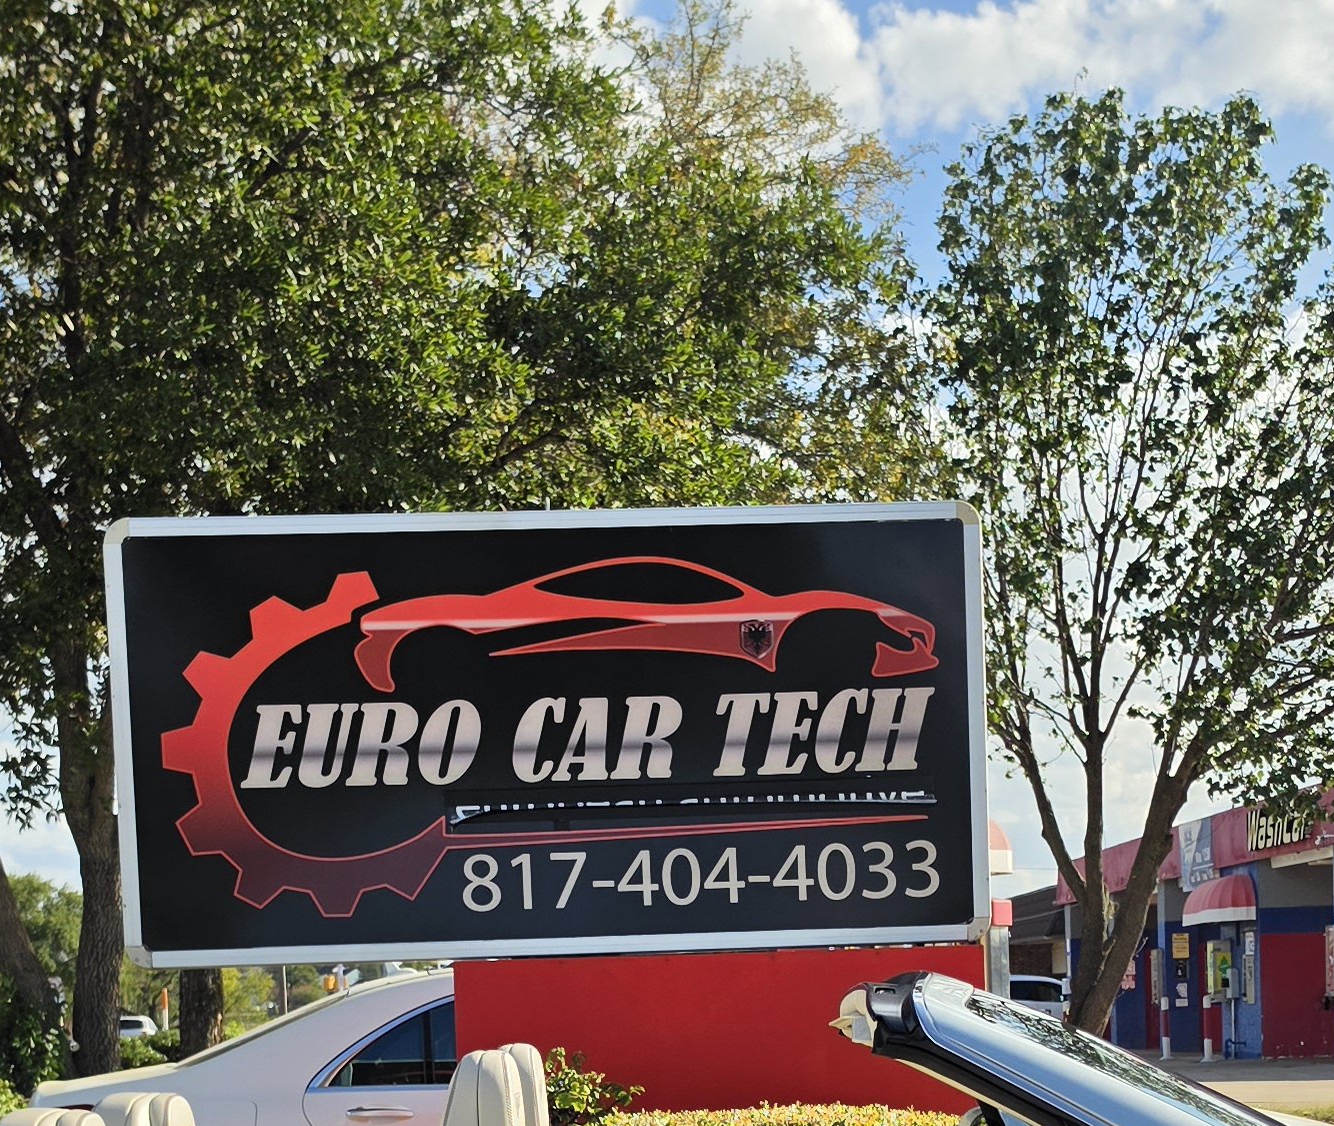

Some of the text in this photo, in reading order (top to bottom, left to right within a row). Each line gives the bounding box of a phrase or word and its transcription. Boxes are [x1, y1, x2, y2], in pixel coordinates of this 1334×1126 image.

[240, 687, 935, 789] EURO CAR TECH
[462, 839, 941, 912] 817-404-4033
